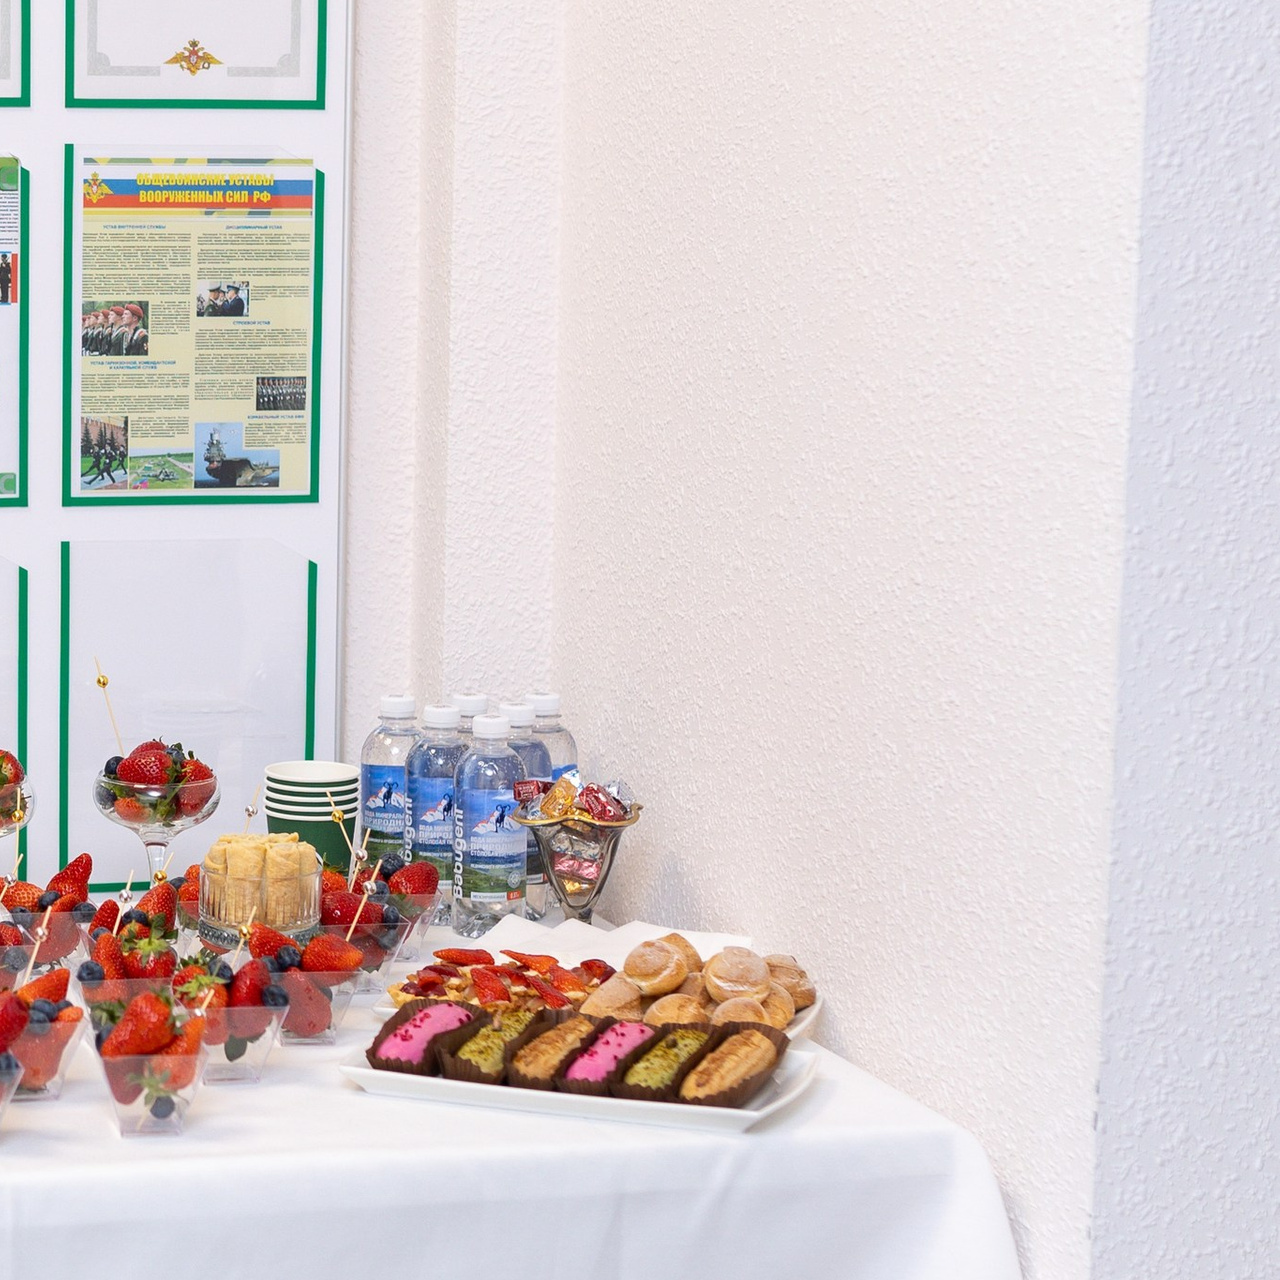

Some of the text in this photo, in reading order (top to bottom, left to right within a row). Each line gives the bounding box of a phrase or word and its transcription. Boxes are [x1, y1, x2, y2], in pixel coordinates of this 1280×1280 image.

[136, 173, 274, 187] ОБЩЕВОИНСКИЕ УСТАВЫ
[139, 190, 271, 203] ВООРУЖЕННЫХ СИЛ РФ
